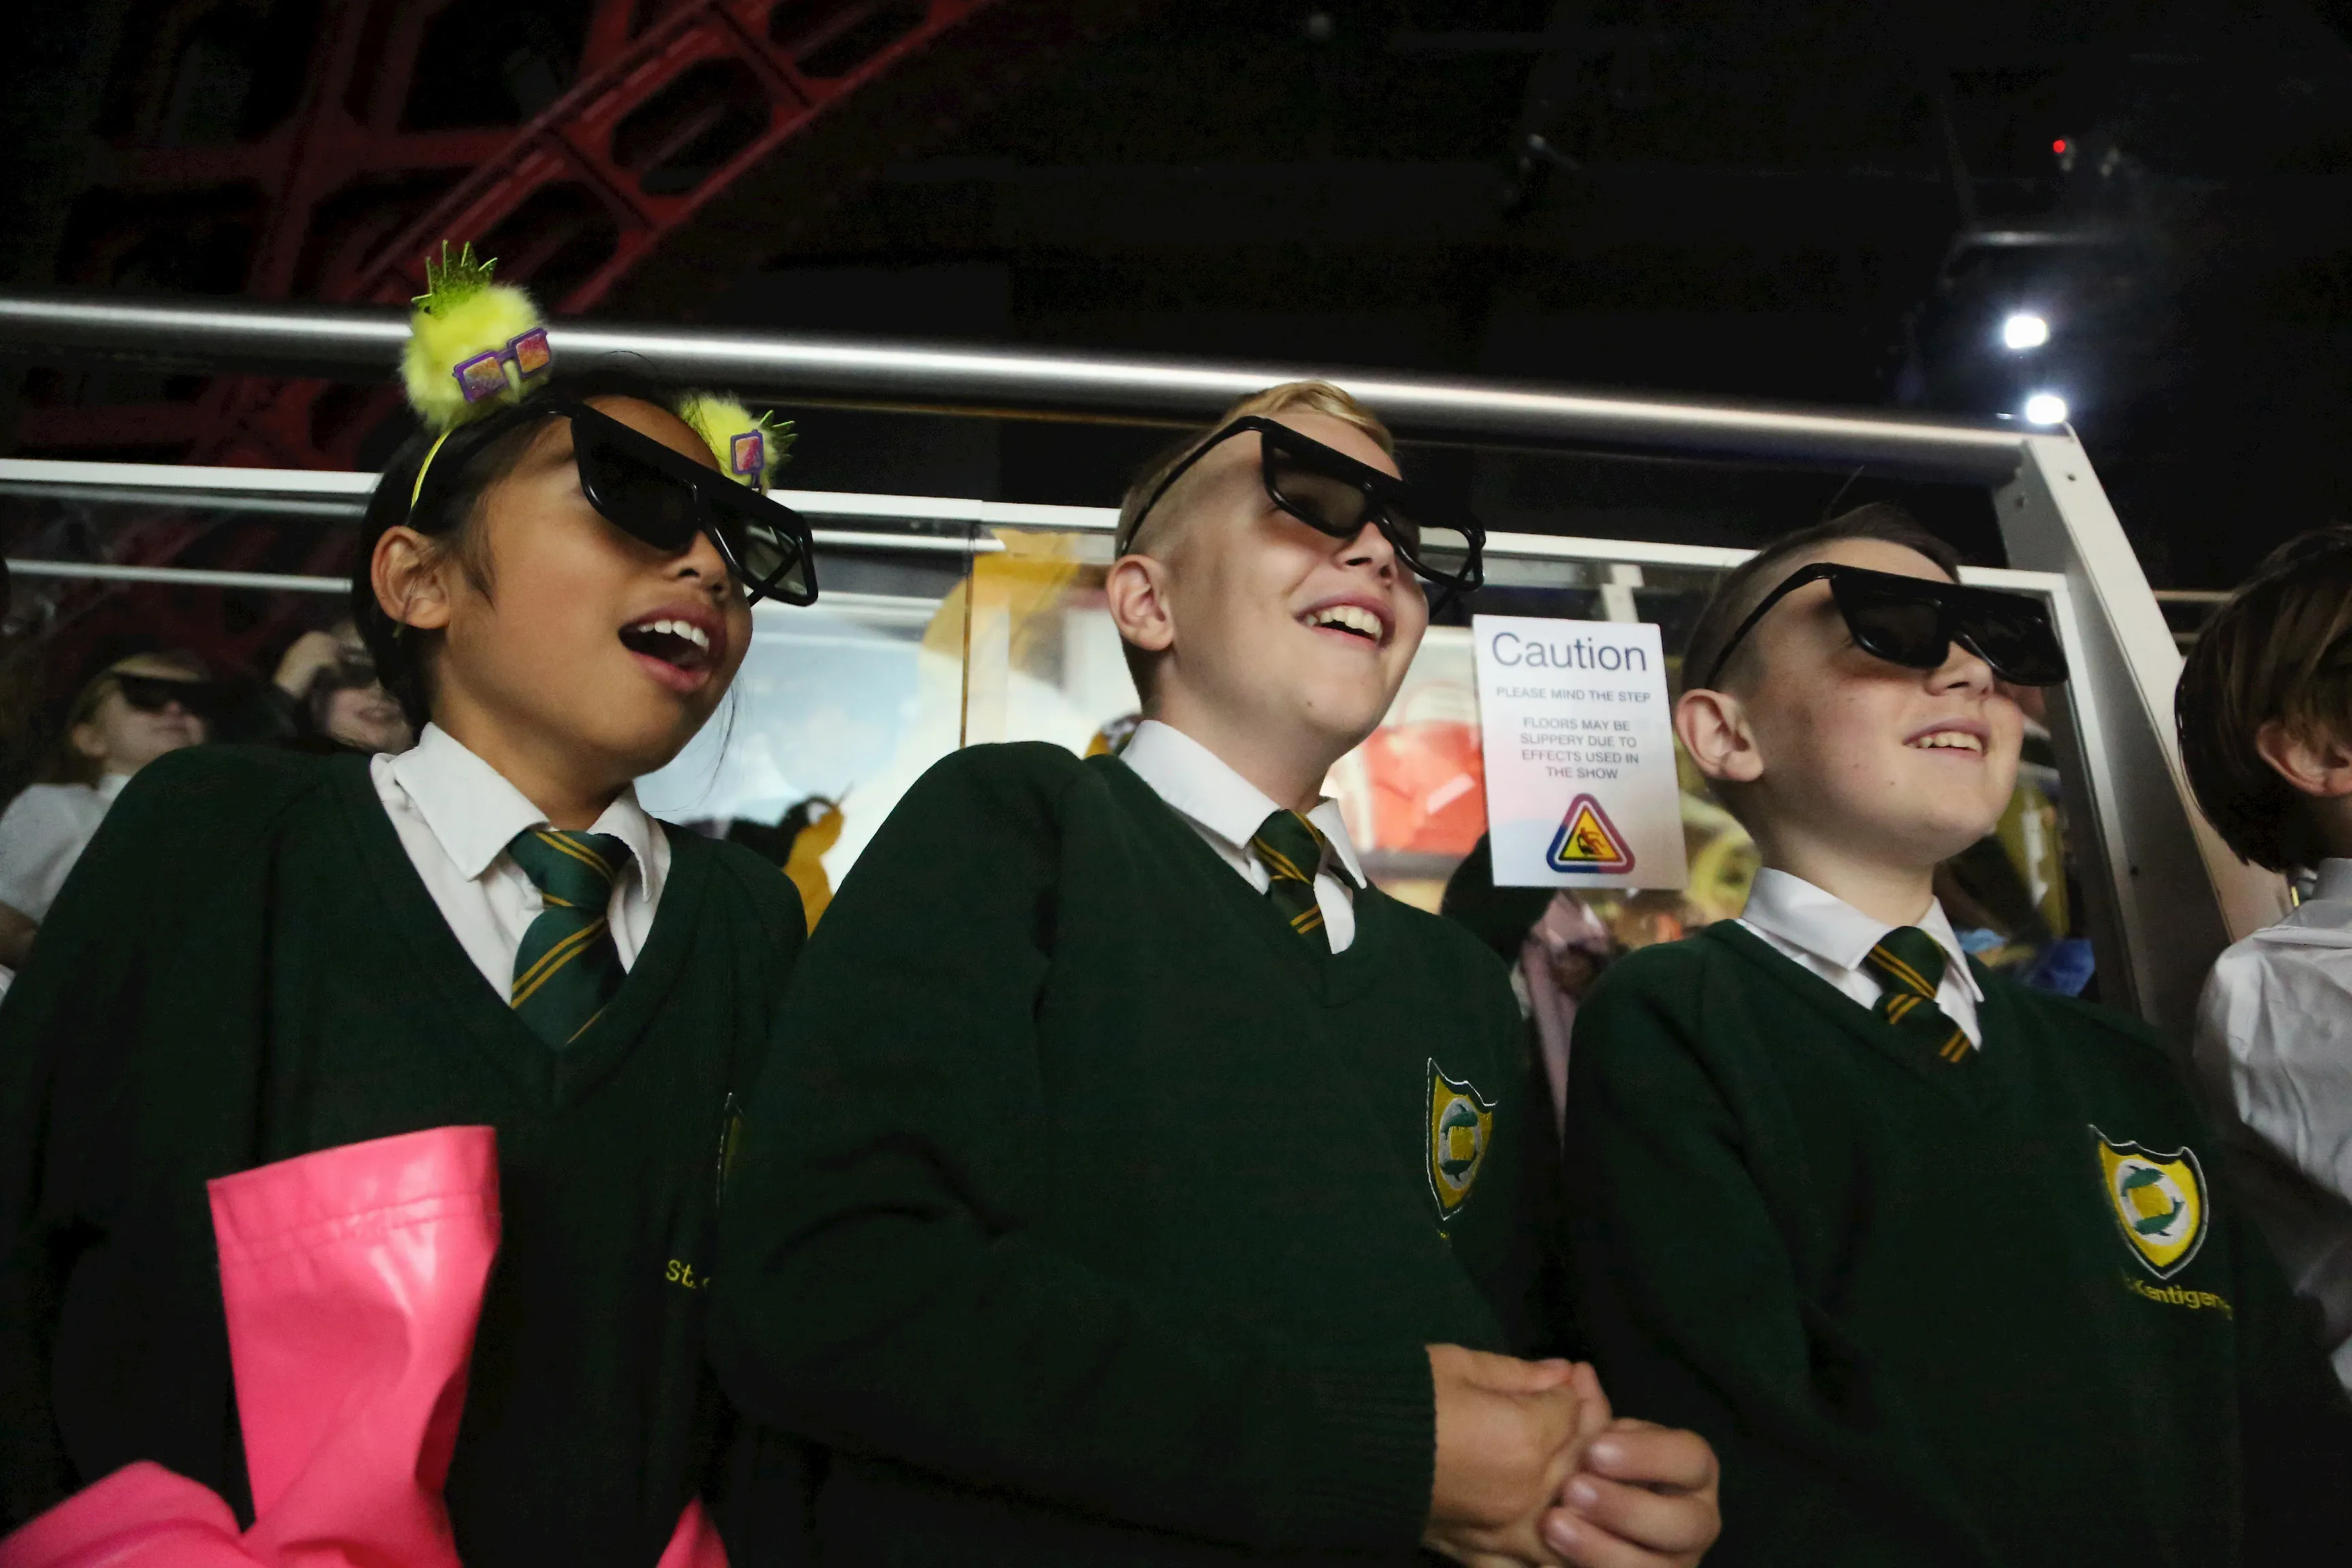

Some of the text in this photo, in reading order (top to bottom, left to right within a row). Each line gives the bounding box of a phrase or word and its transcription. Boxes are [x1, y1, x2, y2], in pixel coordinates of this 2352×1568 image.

[1491, 631, 1648, 672] Caution
[1497, 686, 1651, 703] PLEASE MIND THE STEP
[1523, 717, 1630, 732] FLOORS MAY BE
[1521, 732, 1637, 748] SLIPPERY DUE TO
[1522, 749, 1639, 764] EFFECTS USED IN
[1546, 766, 1618, 779] THE SHOW
